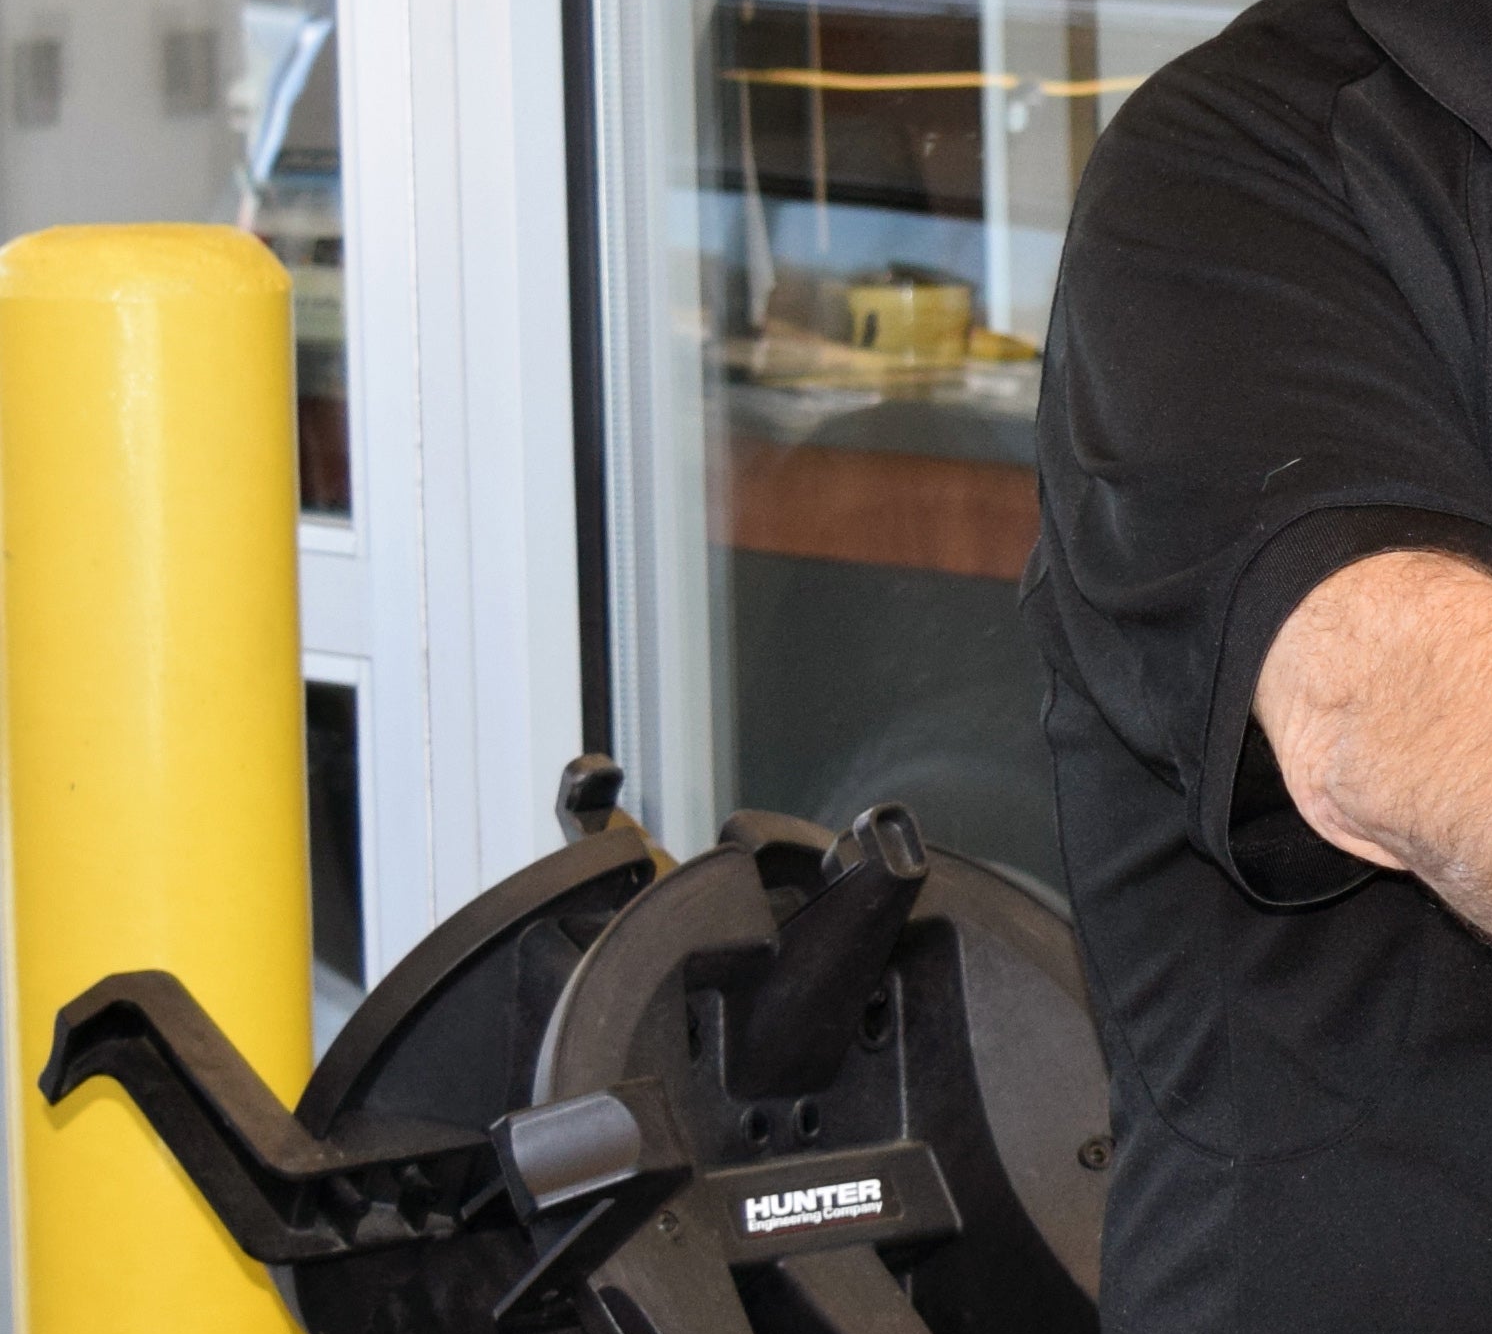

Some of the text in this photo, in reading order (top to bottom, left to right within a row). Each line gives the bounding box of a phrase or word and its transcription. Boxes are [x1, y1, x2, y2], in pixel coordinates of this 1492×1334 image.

[745, 1178, 882, 1218] HUNTER
[747, 1201, 883, 1233] Engineering Company
